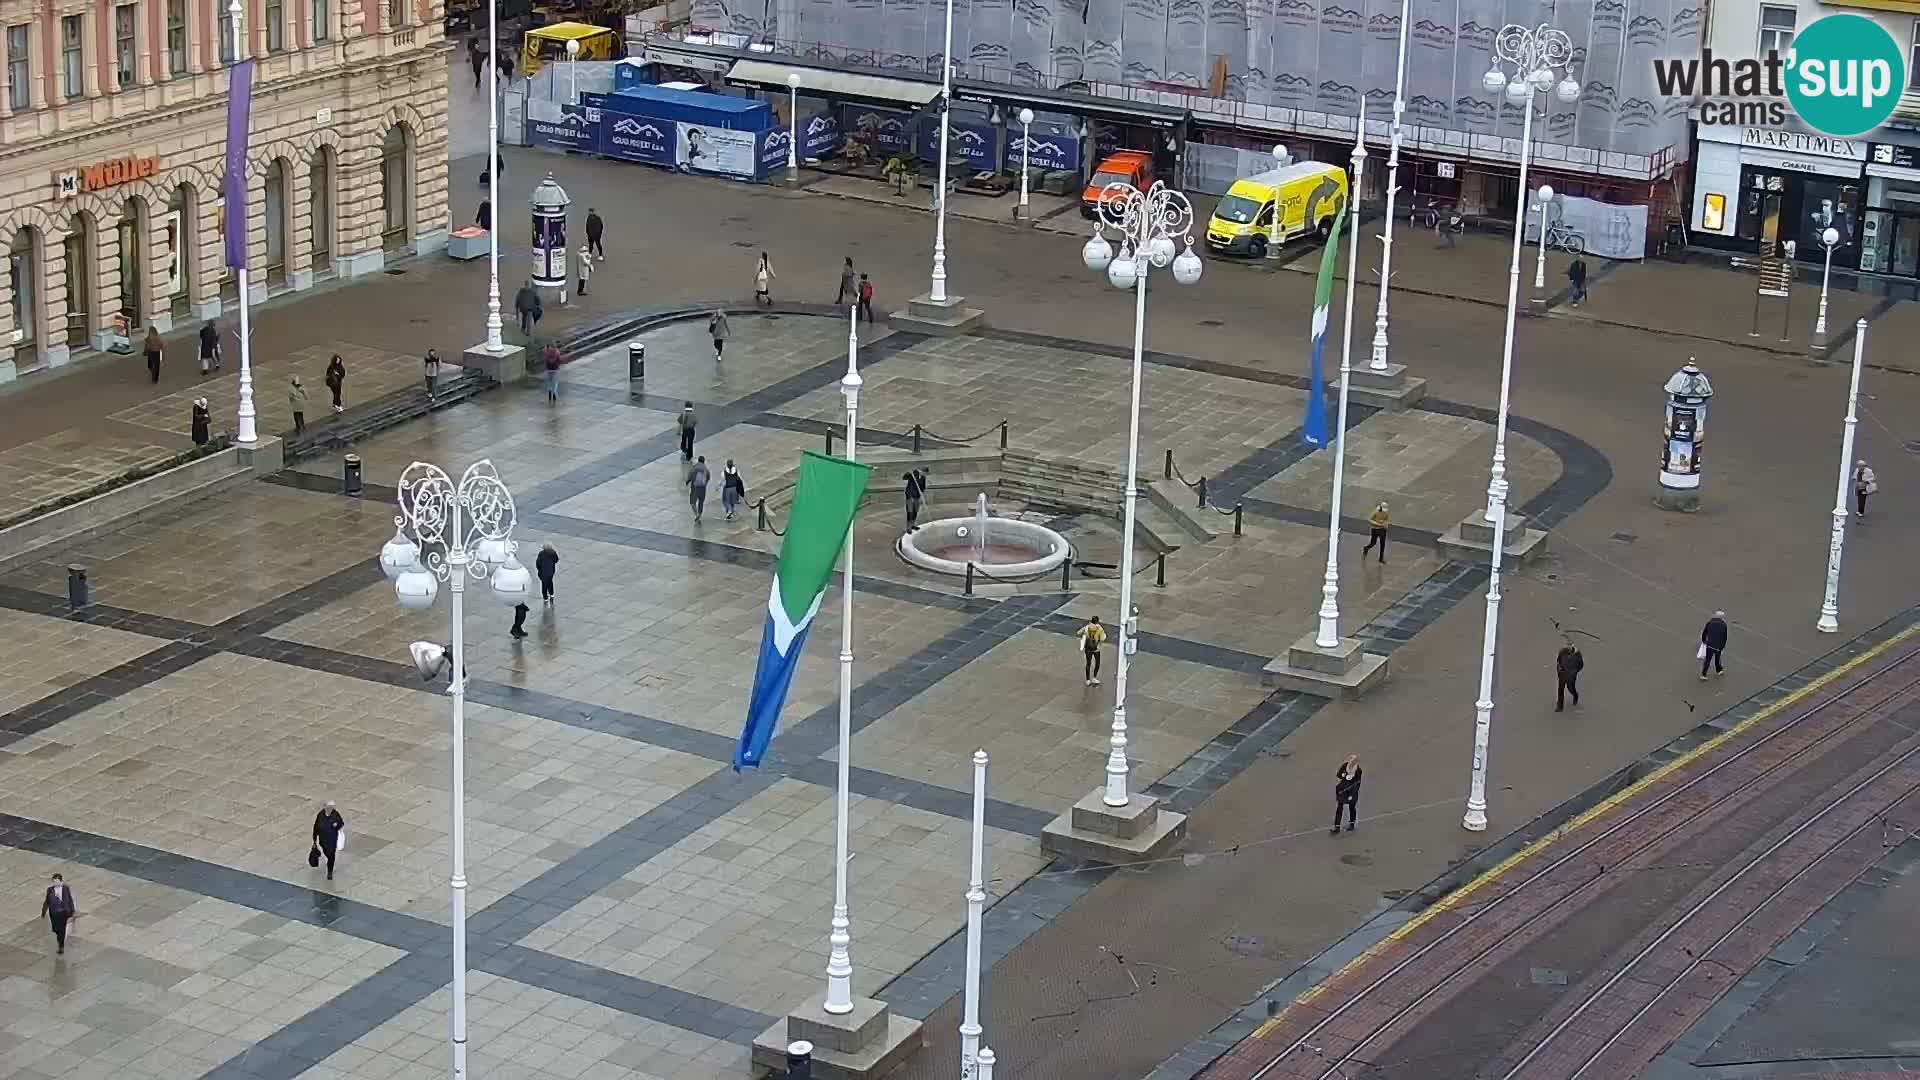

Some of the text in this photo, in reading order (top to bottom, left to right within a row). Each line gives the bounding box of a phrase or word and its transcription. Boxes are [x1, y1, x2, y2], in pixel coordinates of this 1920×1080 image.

[1745, 128, 1857, 156] MARTIMEX
[85, 157, 161, 191] Müller
[1781, 161, 1818, 172] CHANEL
[62, 176, 74, 192] M
